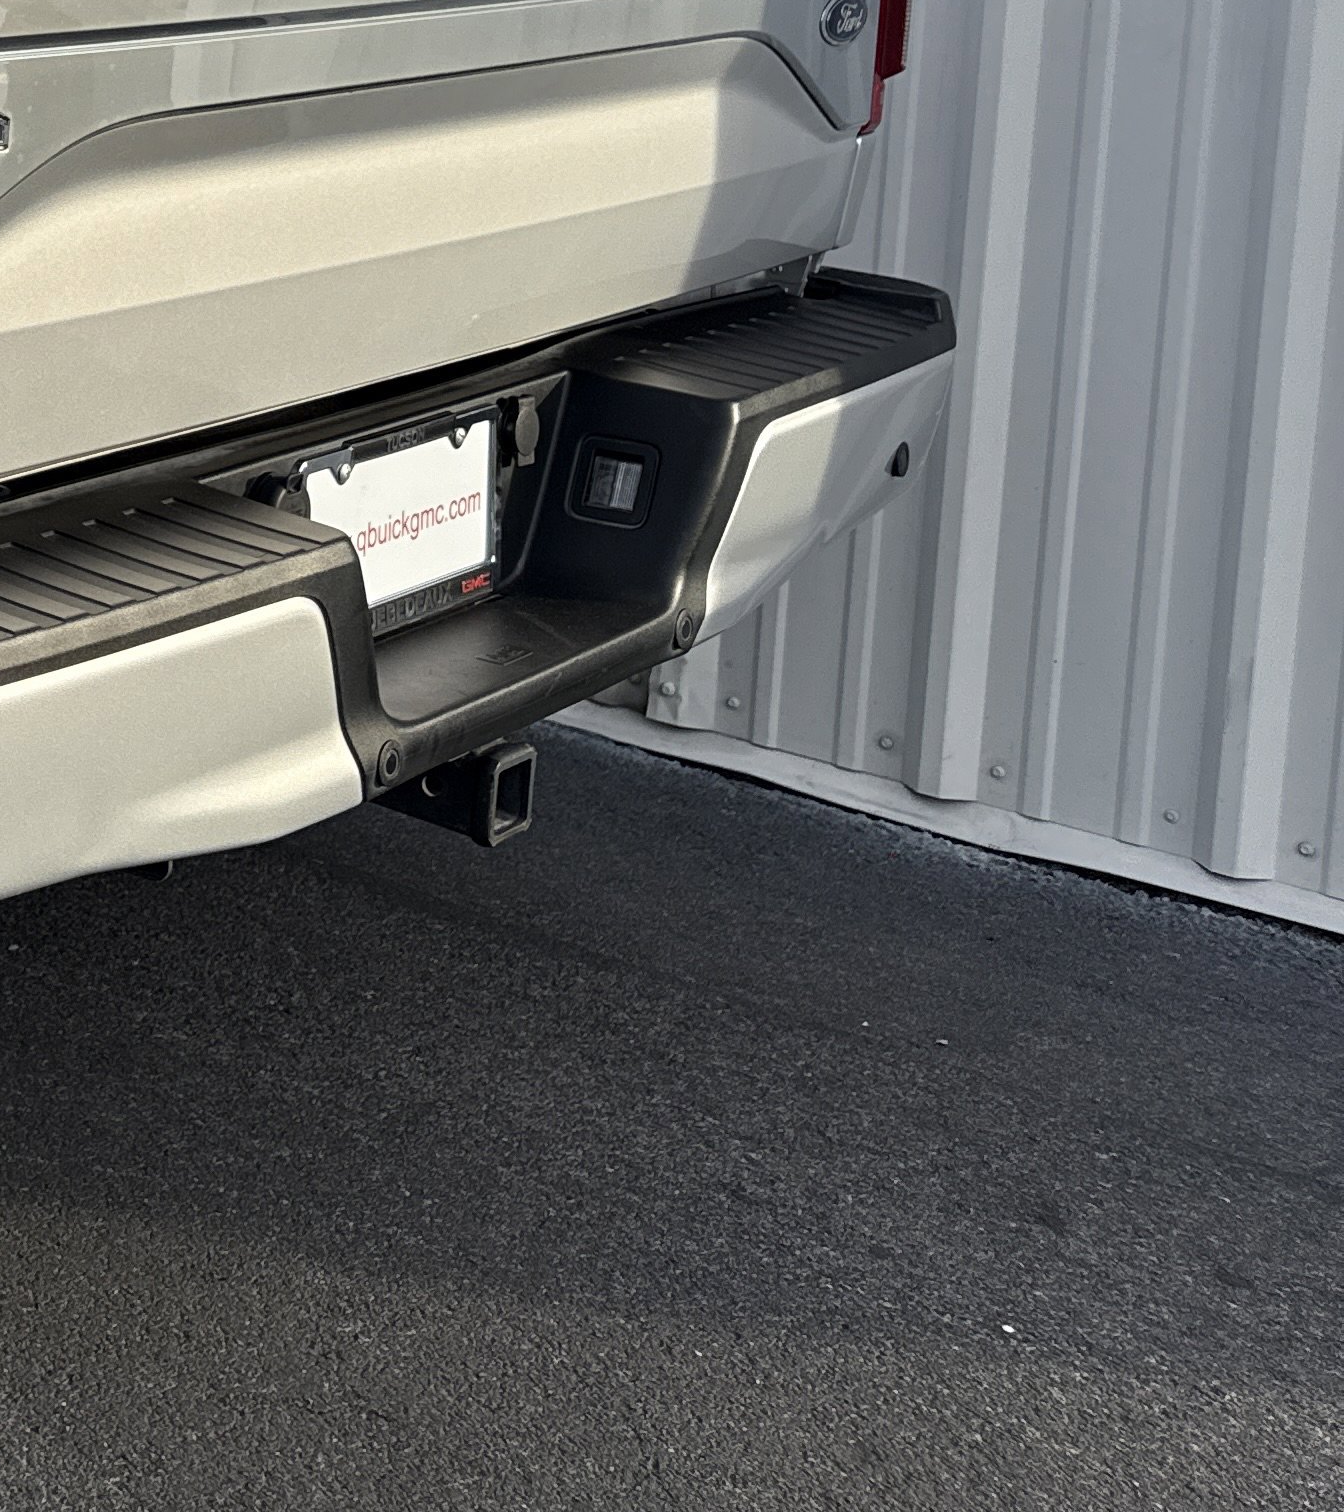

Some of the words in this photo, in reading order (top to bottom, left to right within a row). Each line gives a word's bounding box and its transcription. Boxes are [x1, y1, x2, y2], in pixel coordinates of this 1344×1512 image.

[385, 424, 426, 453] TUCSON
[356, 491, 481, 557] qbuickgmc.com
[462, 571, 491, 594] GMC
